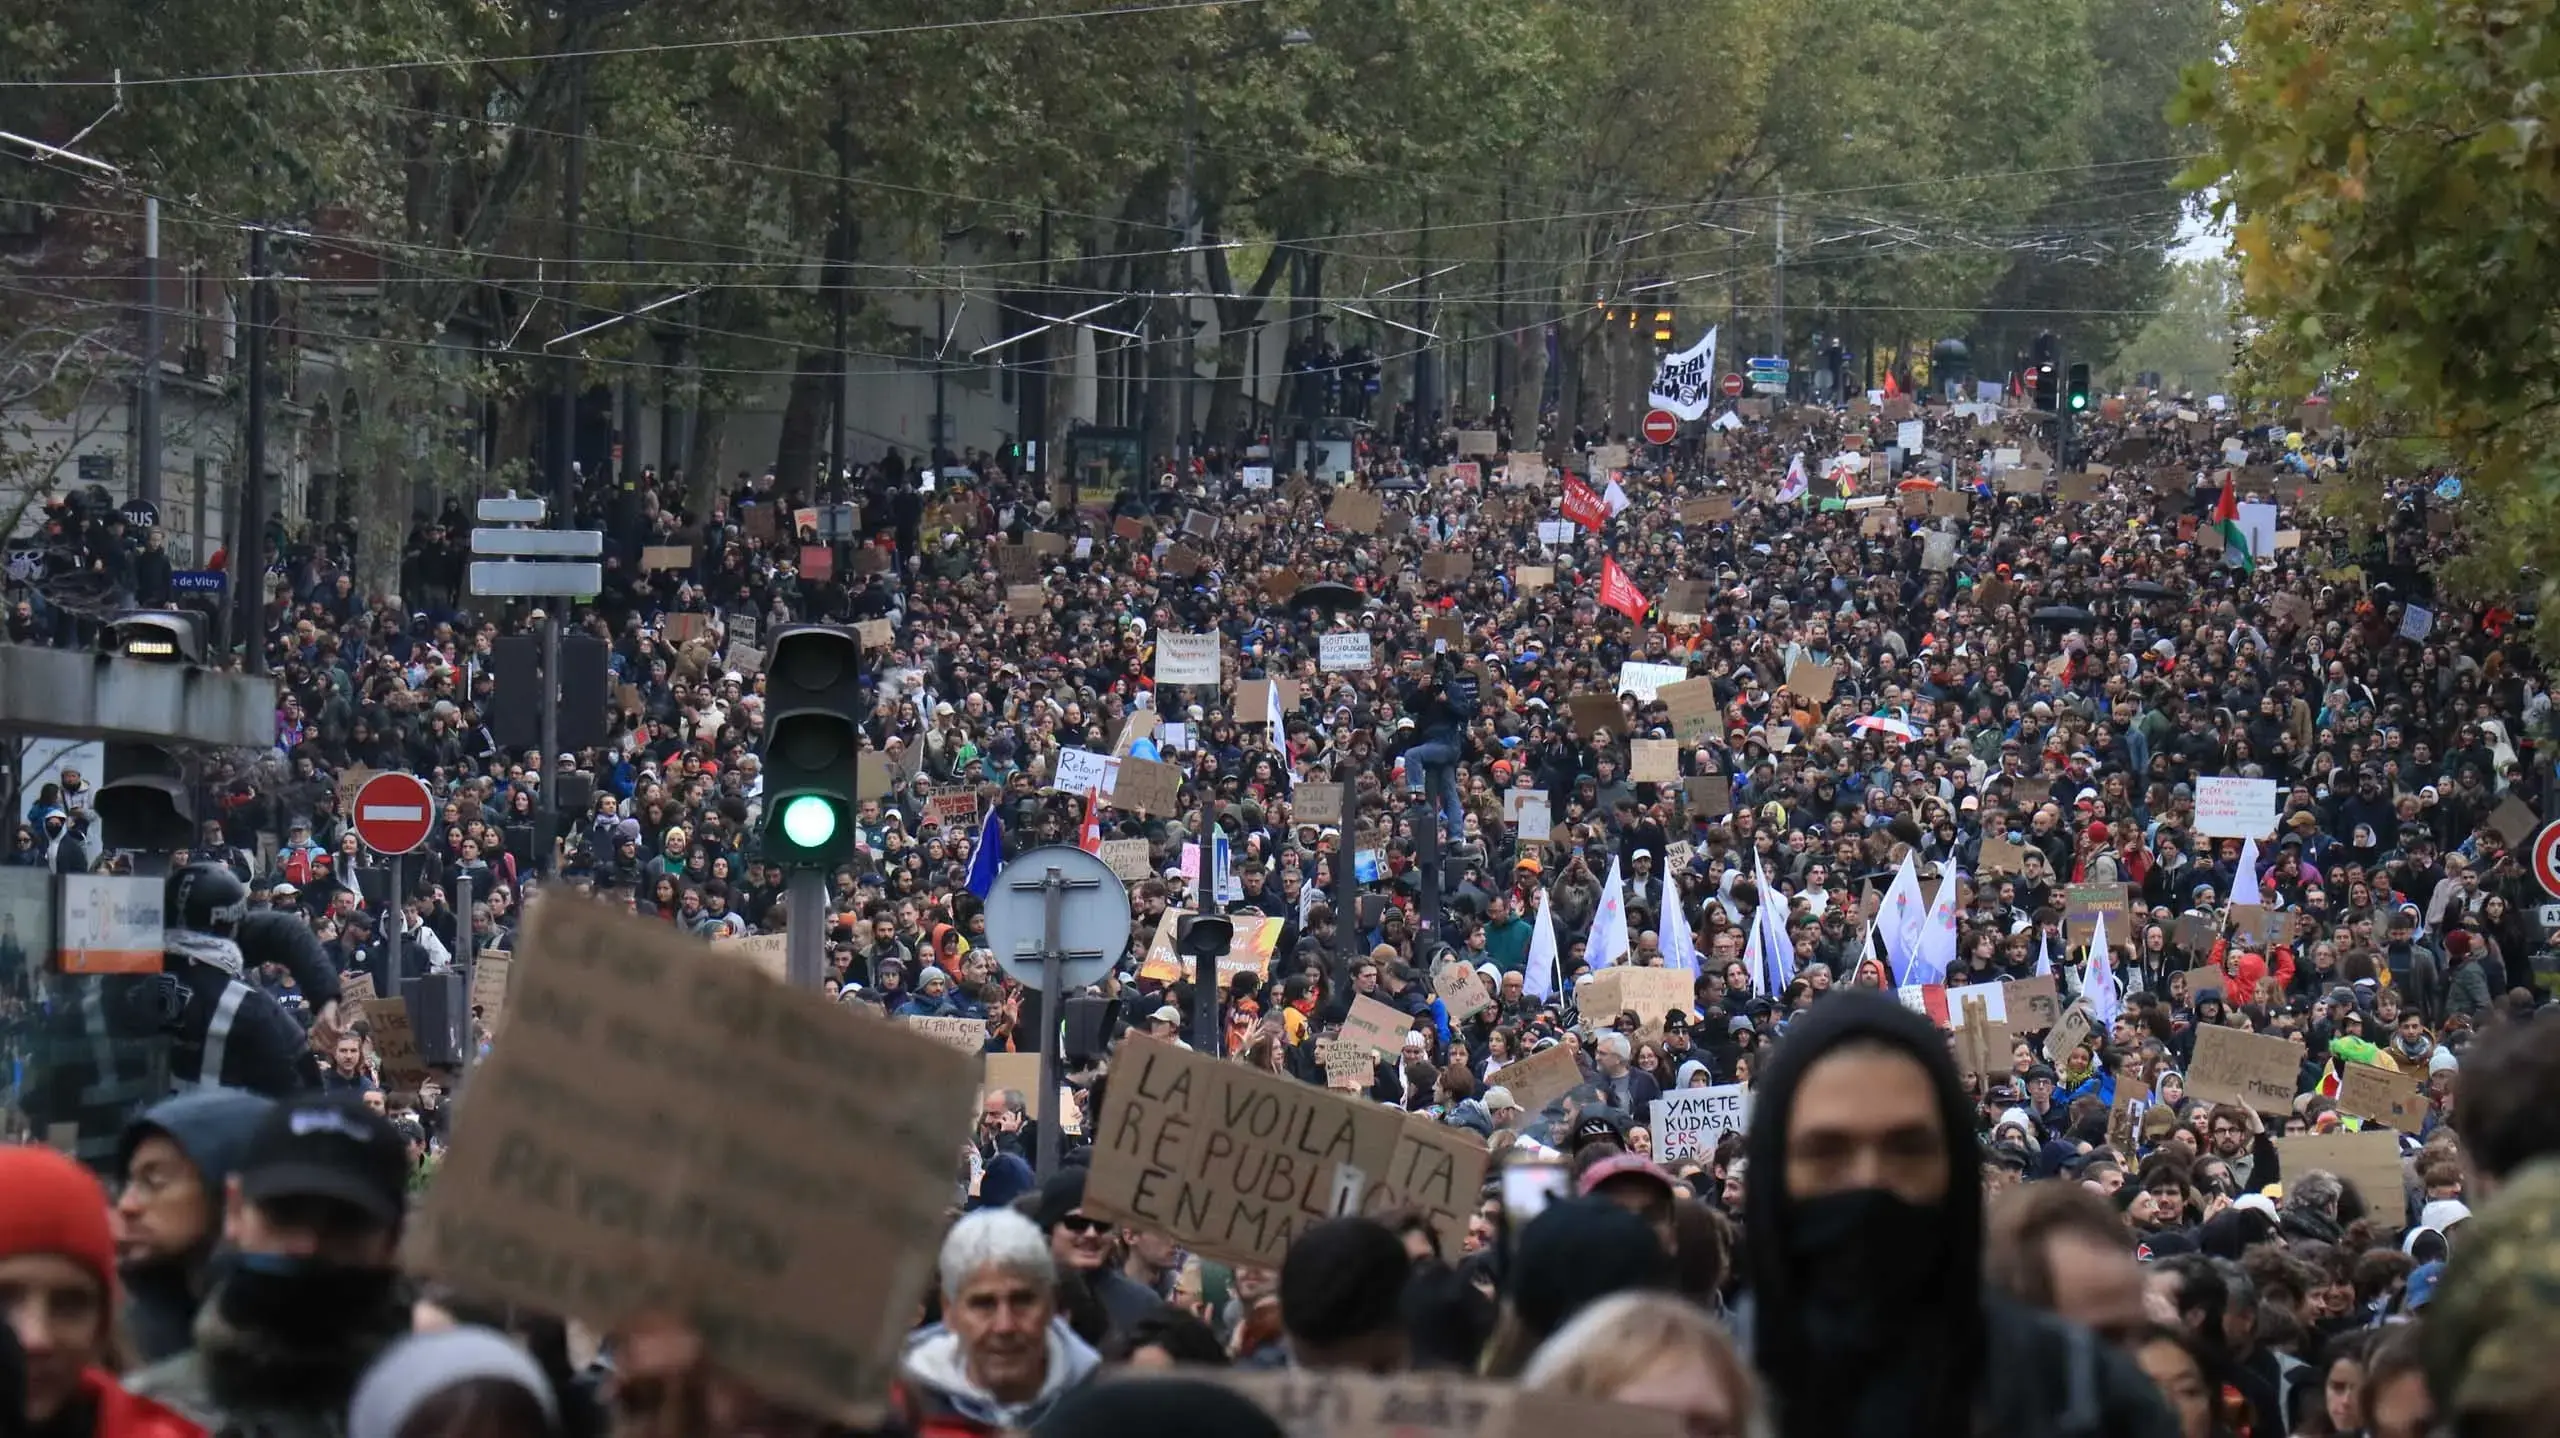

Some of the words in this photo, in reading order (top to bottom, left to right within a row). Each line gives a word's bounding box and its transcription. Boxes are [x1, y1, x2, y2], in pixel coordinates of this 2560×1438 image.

[195, 576, 220, 589] Vitry
[1060, 751, 1102, 774] Retour
[943, 811, 977, 826] MORT
[959, 1022, 982, 1037] QUE
[1666, 1095, 1741, 1116] YAMETE
[1138, 1053, 1193, 1113] LA
[1404, 1133, 1456, 1206] TA
[1664, 1114, 1742, 1132] KUDASAI
[1664, 1130, 1698, 1146] CRS
[1131, 1167, 1214, 1232] EN
